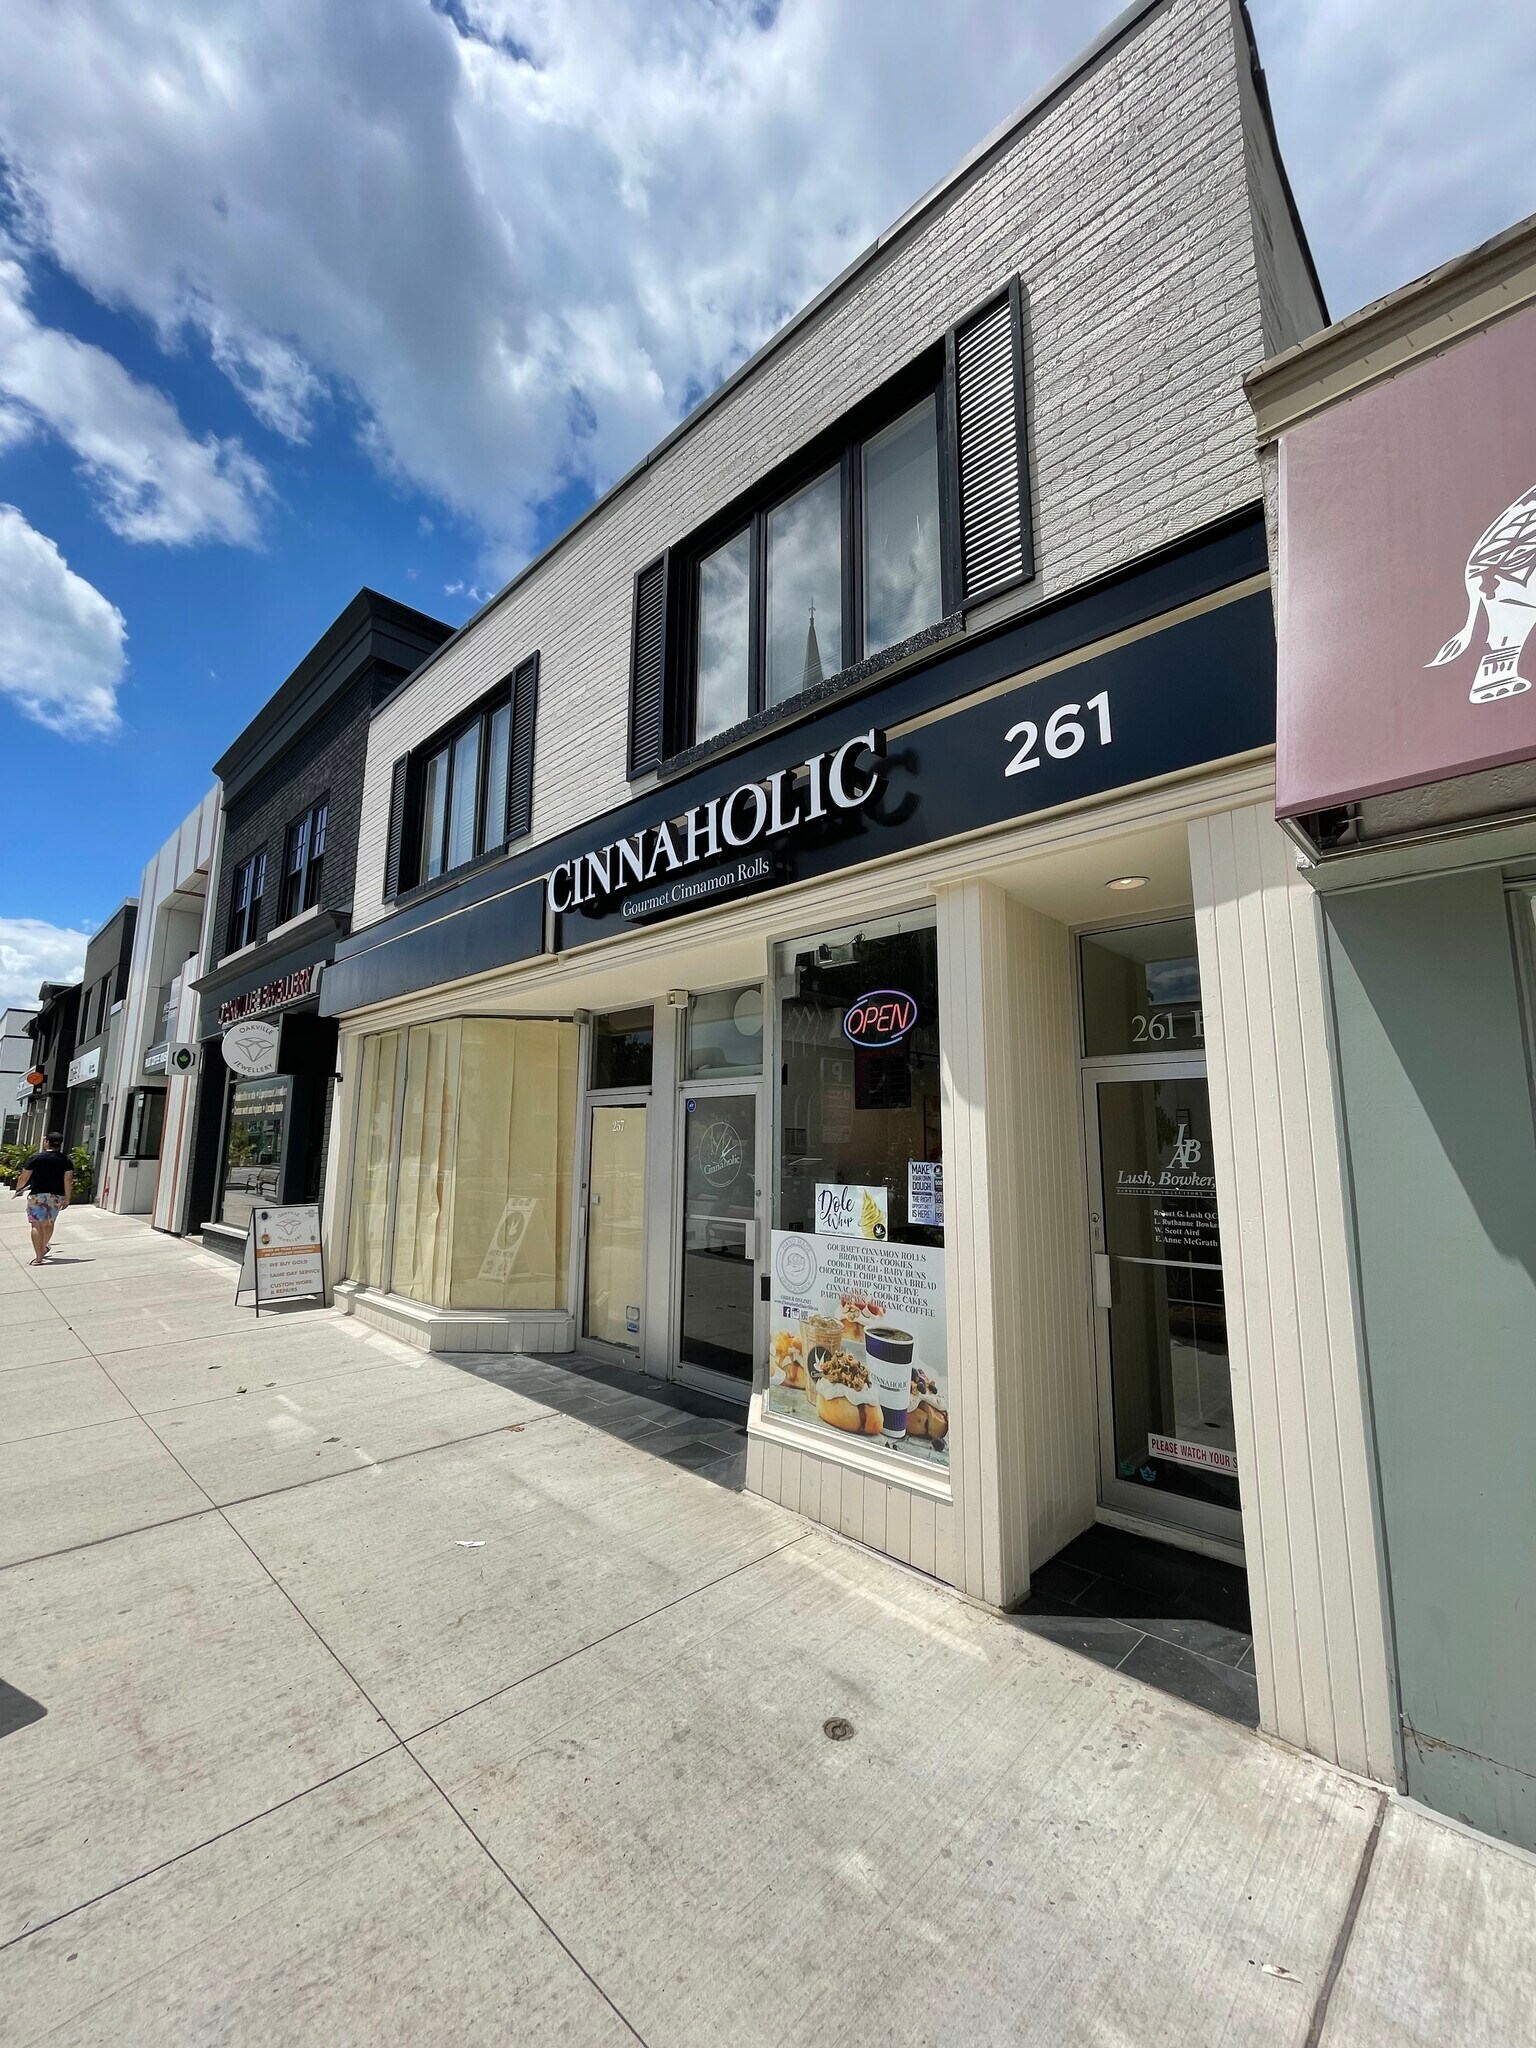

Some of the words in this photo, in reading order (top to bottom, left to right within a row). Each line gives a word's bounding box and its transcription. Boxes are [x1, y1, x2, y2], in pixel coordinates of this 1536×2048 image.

[1004, 690, 1112, 777] 261
[547, 728, 881, 913] CINNAHOLIC
[622, 892, 670, 917] Gourmet
[671, 872, 735, 902] Cinnamon
[737, 857, 770, 882] Rolls
[847, 1001, 910, 1035] OPEN
[1131, 1012, 1177, 1042] 261
[239, 1024, 274, 1036] OAKVILLE
[233, 1060, 273, 1073] JEWELLERY
[612, 1120, 625, 1132] 257
[703, 1154, 741, 1175] Cinnaholic
[912, 1164, 930, 1175] MAKE
[912, 1182, 932, 1191] DOUGH
[1117, 1170, 1156, 1187] Lush,
[1158, 1171, 1216, 1189] Bowker,
[818, 1186, 856, 1219] Dole
[823, 1211, 855, 1230] Whip
[912, 1210, 917, 1218] IS
[1162, 1218, 1194, 1227] Ruthanne
[1196, 1220, 1219, 1228] Bowke
[1186, 1211, 1203, 1219] Lush
[1164, 1227, 1182, 1235] Scott
[1184, 1228, 1200, 1236] Aird
[1163, 1236, 1182, 1244] Anne
[1183, 1238, 1218, 1247] McGrath
[826, 1243, 860, 1254] GOURMET
[861, 1247, 899, 1259] CINNAMON
[901, 1251, 926, 1262] ROLLS
[838, 1252, 875, 1264] BROWNIES
[880, 1257, 913, 1269] COOKIES
[818, 1265, 857, 1279] CHOCOLATE
[858, 1271, 876, 1281] CHIP
[878, 1274, 908, 1286] BANANA
[909, 1279, 937, 1291] BREAD
[827, 1258, 852, 1269] COOKIE
[853, 1262, 878, 1273] DOUGH
[884, 1266, 904, 1277] BABY
[905, 1270, 926, 1280] BUNS
[270, 1281, 294, 1289] CUSTOM
[834, 1276, 852, 1286] DOLE
[853, 1279, 872, 1289] WHIP
[872, 1281, 892, 1292] SOFT
[893, 1285, 919, 1297] SERVE
[820, 1290, 841, 1301] PARTY
[905, 1304, 936, 1317] COFFEE
[826, 1283, 869, 1297] CINNACAKES
[873, 1290, 900, 1303] COOKIE
[902, 1295, 928, 1307] CAKES
[870, 1372, 908, 1389] CINNAHOLIC
[1151, 1438, 1179, 1455] PLEASE
[1180, 1444, 1207, 1462] WATCH
[1208, 1451, 1231, 1467] YOUR
